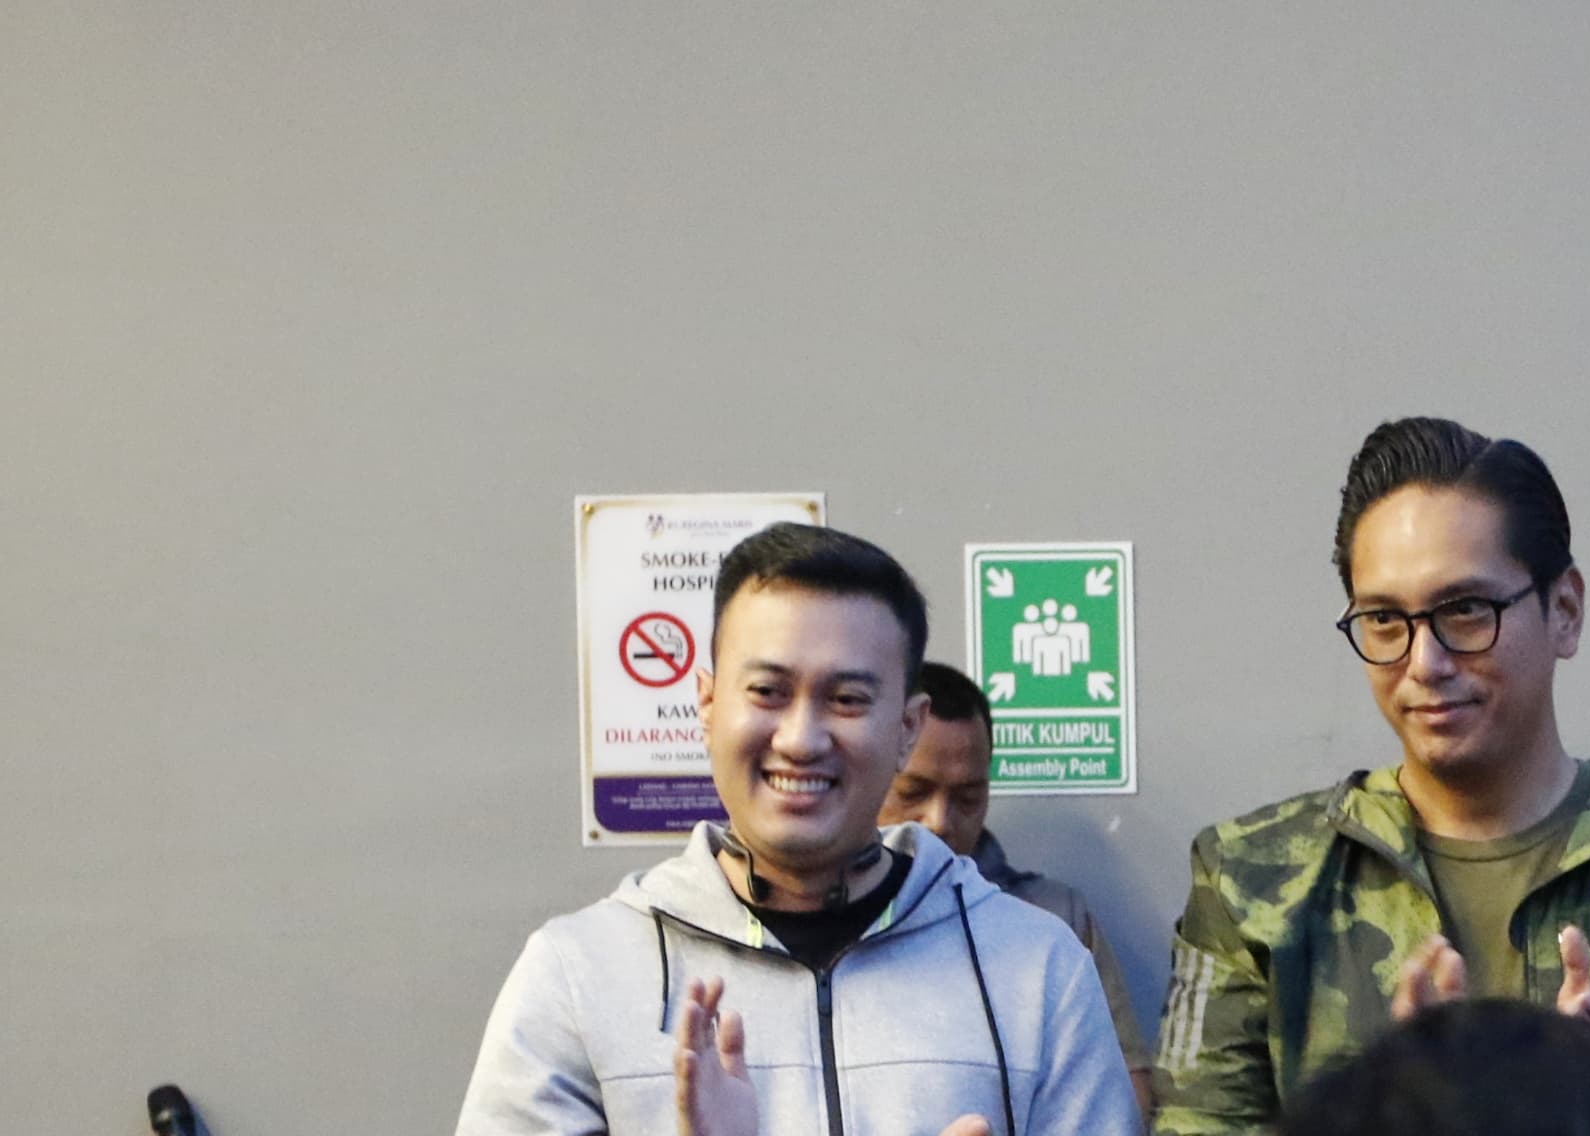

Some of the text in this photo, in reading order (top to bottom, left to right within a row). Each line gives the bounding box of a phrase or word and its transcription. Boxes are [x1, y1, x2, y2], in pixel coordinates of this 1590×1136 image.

[640, 552, 729, 568] SMOKE-
[653, 575, 715, 591] HOSPI
[657, 704, 698, 719] KAW
[605, 728, 704, 744] DILARANG
[1039, 722, 1116, 745] KUMPUL
[675, 751, 709, 762] SMOK
[998, 757, 1107, 780] Assembly Point
